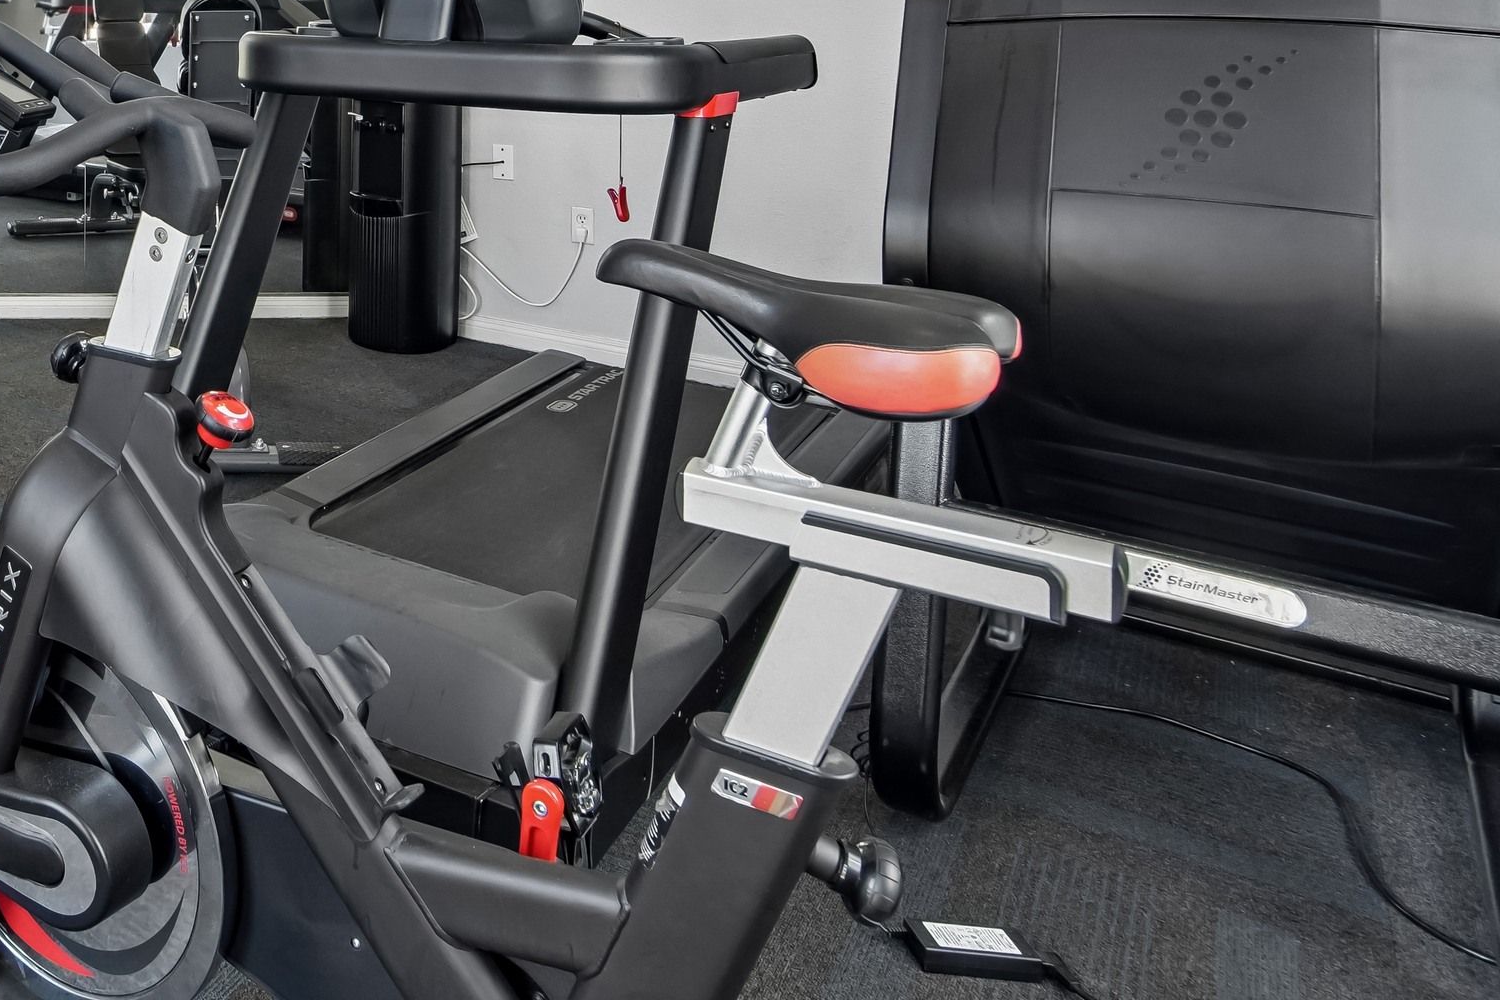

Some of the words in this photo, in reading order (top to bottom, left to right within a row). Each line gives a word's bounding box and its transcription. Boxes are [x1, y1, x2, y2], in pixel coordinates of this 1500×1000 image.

[567, 383, 601, 401] STAR
[591, 369, 624, 389] TRAC
[1166, 575, 1259, 604] StairMaster
[723, 776, 748, 798] IC2
[163, 776, 185, 836] POWERED
[178, 836, 188, 854] BY
